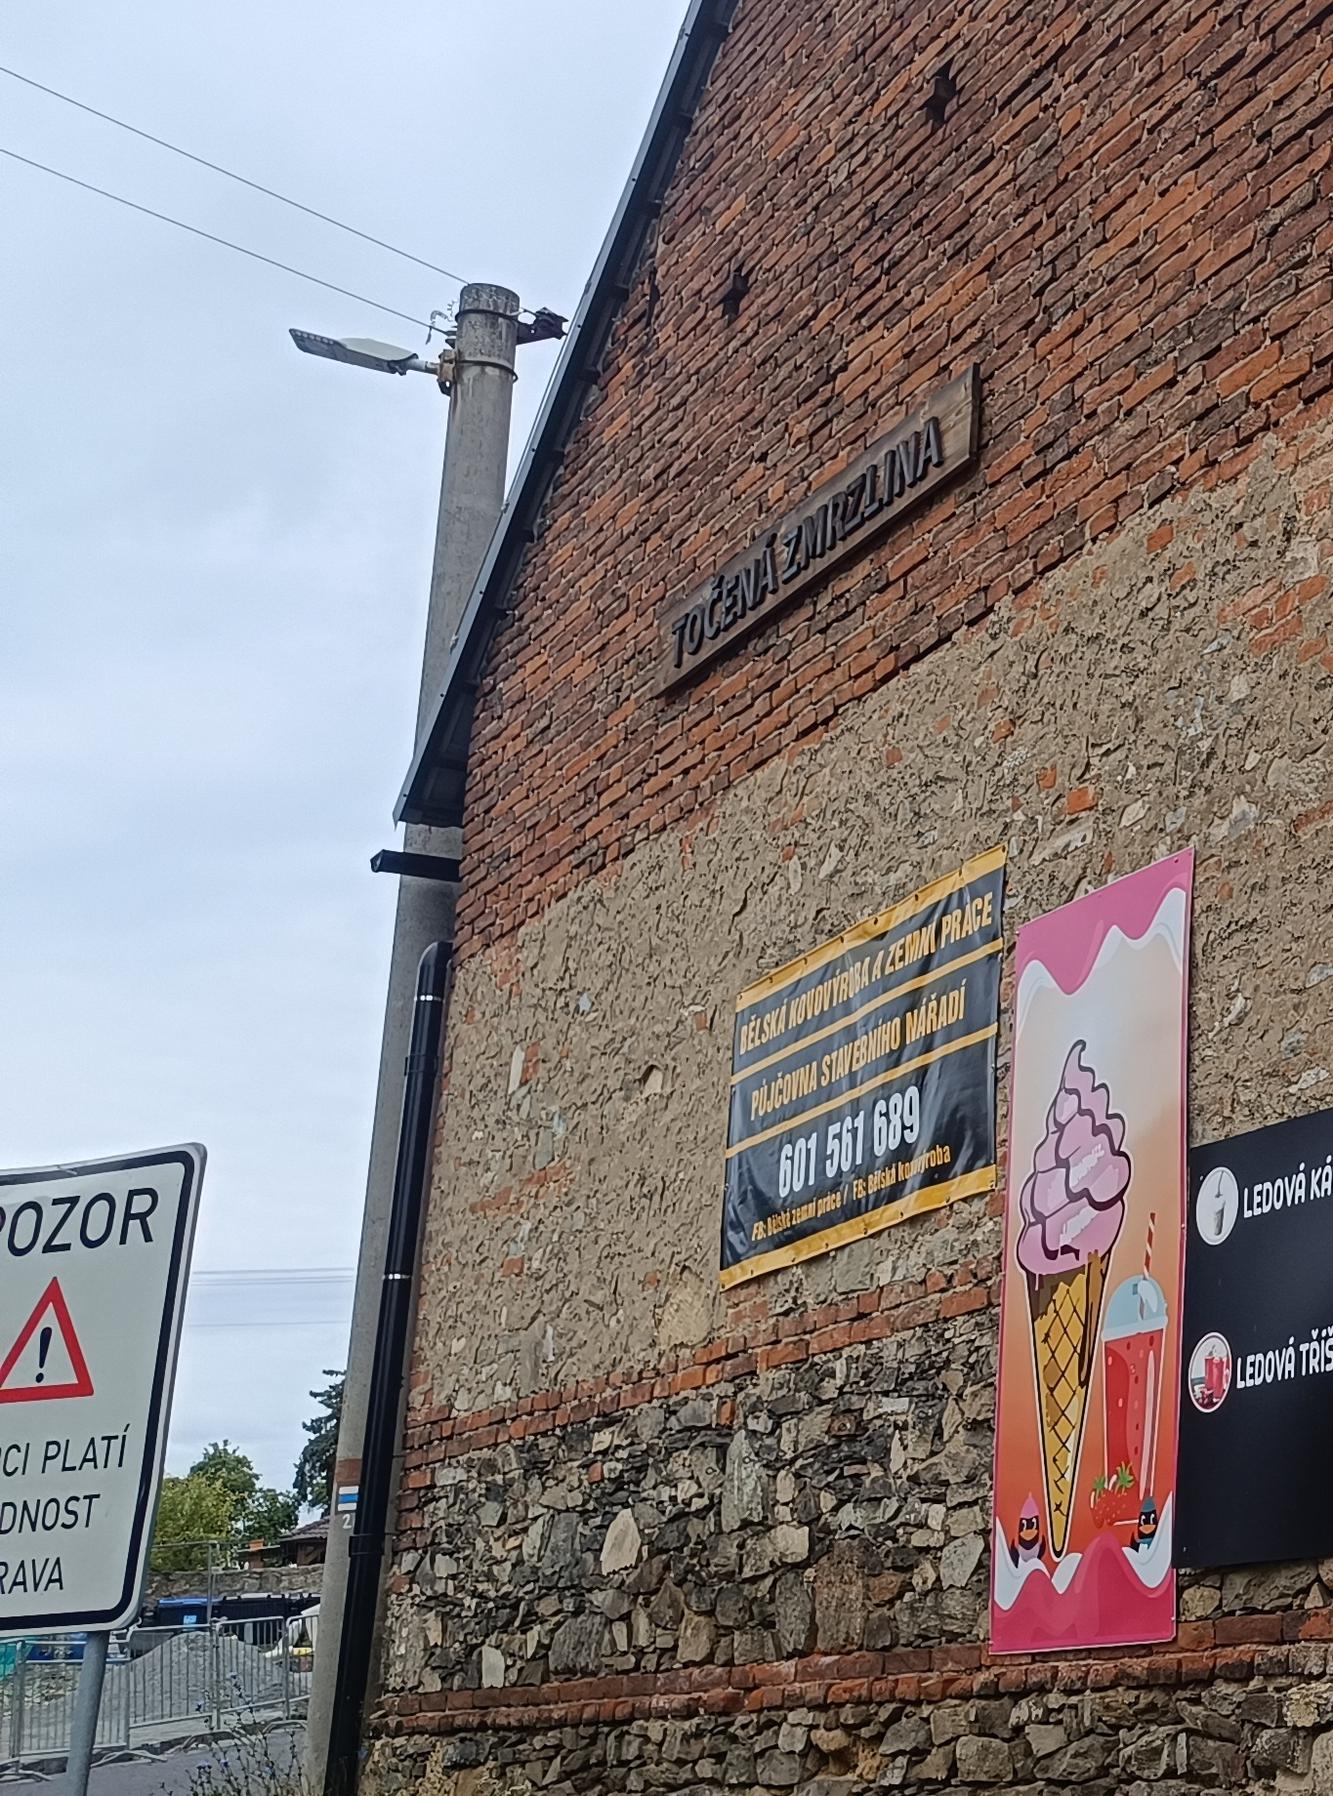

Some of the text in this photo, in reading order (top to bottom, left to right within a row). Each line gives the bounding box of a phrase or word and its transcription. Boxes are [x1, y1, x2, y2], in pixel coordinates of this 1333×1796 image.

[671, 416, 945, 668] TOČENÁ ZMRZLINA
[740, 891, 994, 1055] BĚLSKÁ KOVOVÝROBA A ZEMNÍ PRÁCE
[751, 978, 967, 1121] PŮJČOVNA STAVEBNÍHO NÁŘADÍ
[779, 1085, 920, 1198] 601 561 689
[1243, 1162, 1307, 1218] LEDOVÁ
[1236, 1336, 1295, 1389] LEDOVÁ
[0, 1423, 130, 1477] CI PLATÍ
